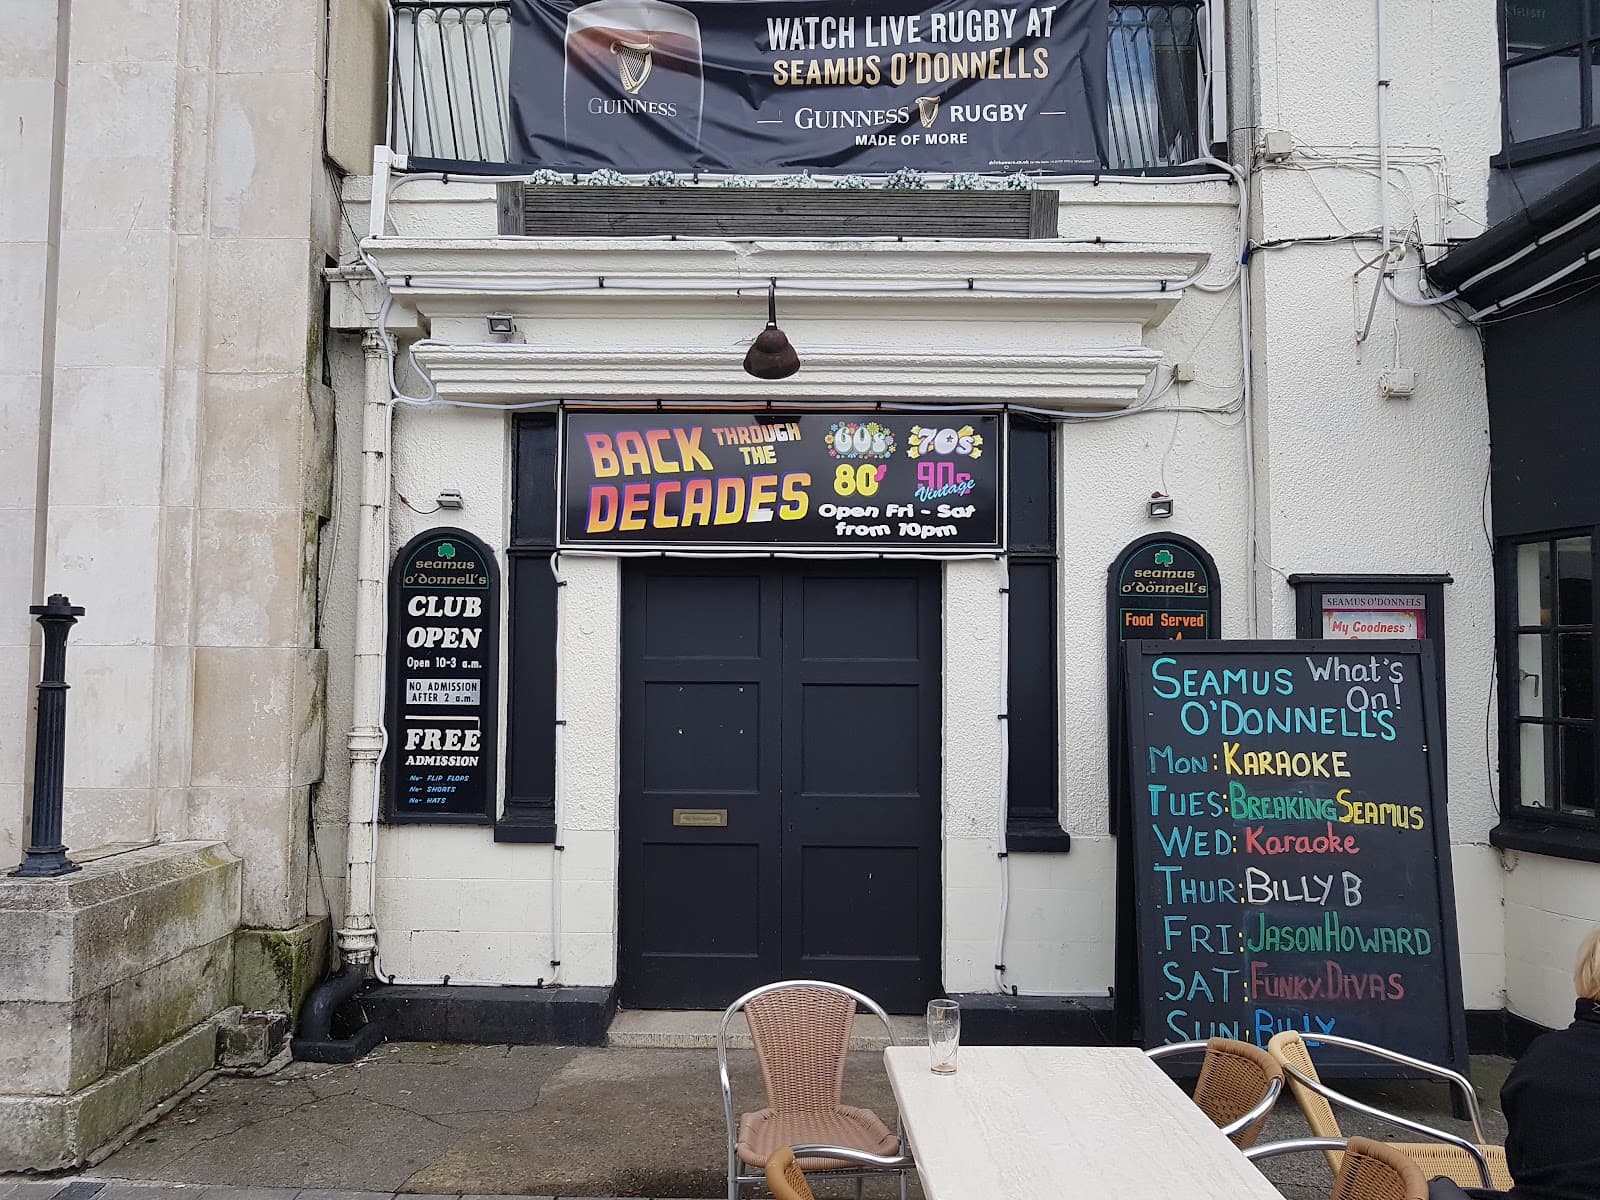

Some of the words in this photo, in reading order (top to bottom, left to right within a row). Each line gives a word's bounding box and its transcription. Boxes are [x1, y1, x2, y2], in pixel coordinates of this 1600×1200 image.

[767, 16, 855, 50] WATCH
[865, 15, 921, 47] LIVE
[931, 9, 1017, 43] RUGBY
[1026, 6, 1056, 37] AT
[773, 55, 881, 86] SEAMUS
[890, 47, 1049, 85] O'DONNELLS
[587, 97, 677, 117] GUINNESS
[794, 107, 909, 129] GUINNESS
[951, 104, 1028, 122] RUGBY
[855, 135, 896, 146] MADE
[900, 134, 920, 145] OF
[925, 133, 968, 145] MORE
[585, 426, 714, 478] BACK
[711, 423, 801, 446] THROUGH
[834, 427, 888, 453] 60s
[917, 428, 975, 455] 70s
[738, 445, 777, 466] THE
[917, 462, 971, 495] 90s
[914, 479, 976, 502] Vintage
[584, 472, 812, 534] DECADES
[818, 503, 880, 520] Open
[886, 503, 914, 518] Fri
[937, 503, 976, 518] Sat
[835, 522, 892, 537] from
[899, 522, 958, 539] 10pm
[415, 560, 475, 569] seamus
[1134, 569, 1196, 579] seamus
[405, 573, 487, 585] o'donnell's
[407, 595, 482, 617] CLUB
[1327, 597, 1366, 606] SEAMUS
[1367, 597, 1421, 607] O'DONNELS
[1125, 612, 1154, 626] Food
[1160, 613, 1204, 627] Served
[1332, 620, 1349, 635] My
[406, 626, 482, 649] OPEN
[406, 656, 431, 670] Open
[435, 657, 457, 668] 10-3
[462, 660, 482, 669] a.m.
[409, 682, 422, 692] NO
[427, 682, 478, 692] ADMISSION
[1151, 657, 1294, 699] SEAMUS
[1305, 655, 1404, 684] What's
[412, 693, 439, 703] AFTER
[444, 694, 450, 702] 2
[455, 694, 475, 703] a.m.
[1346, 683, 1401, 713] On!
[404, 728, 481, 752] FREE
[404, 755, 480, 767] ADMISSION
[1223, 741, 1351, 778] KARAOKE
[1229, 780, 1338, 821] BREAKING
[1335, 788, 1425, 831] SEAMUS
[1244, 822, 1361, 855] Karaoke
[1245, 866, 1334, 906] BILLY
[1341, 870, 1363, 907] B
[1247, 912, 1322, 954] JASON
[1324, 911, 1432, 956] HOWARD
